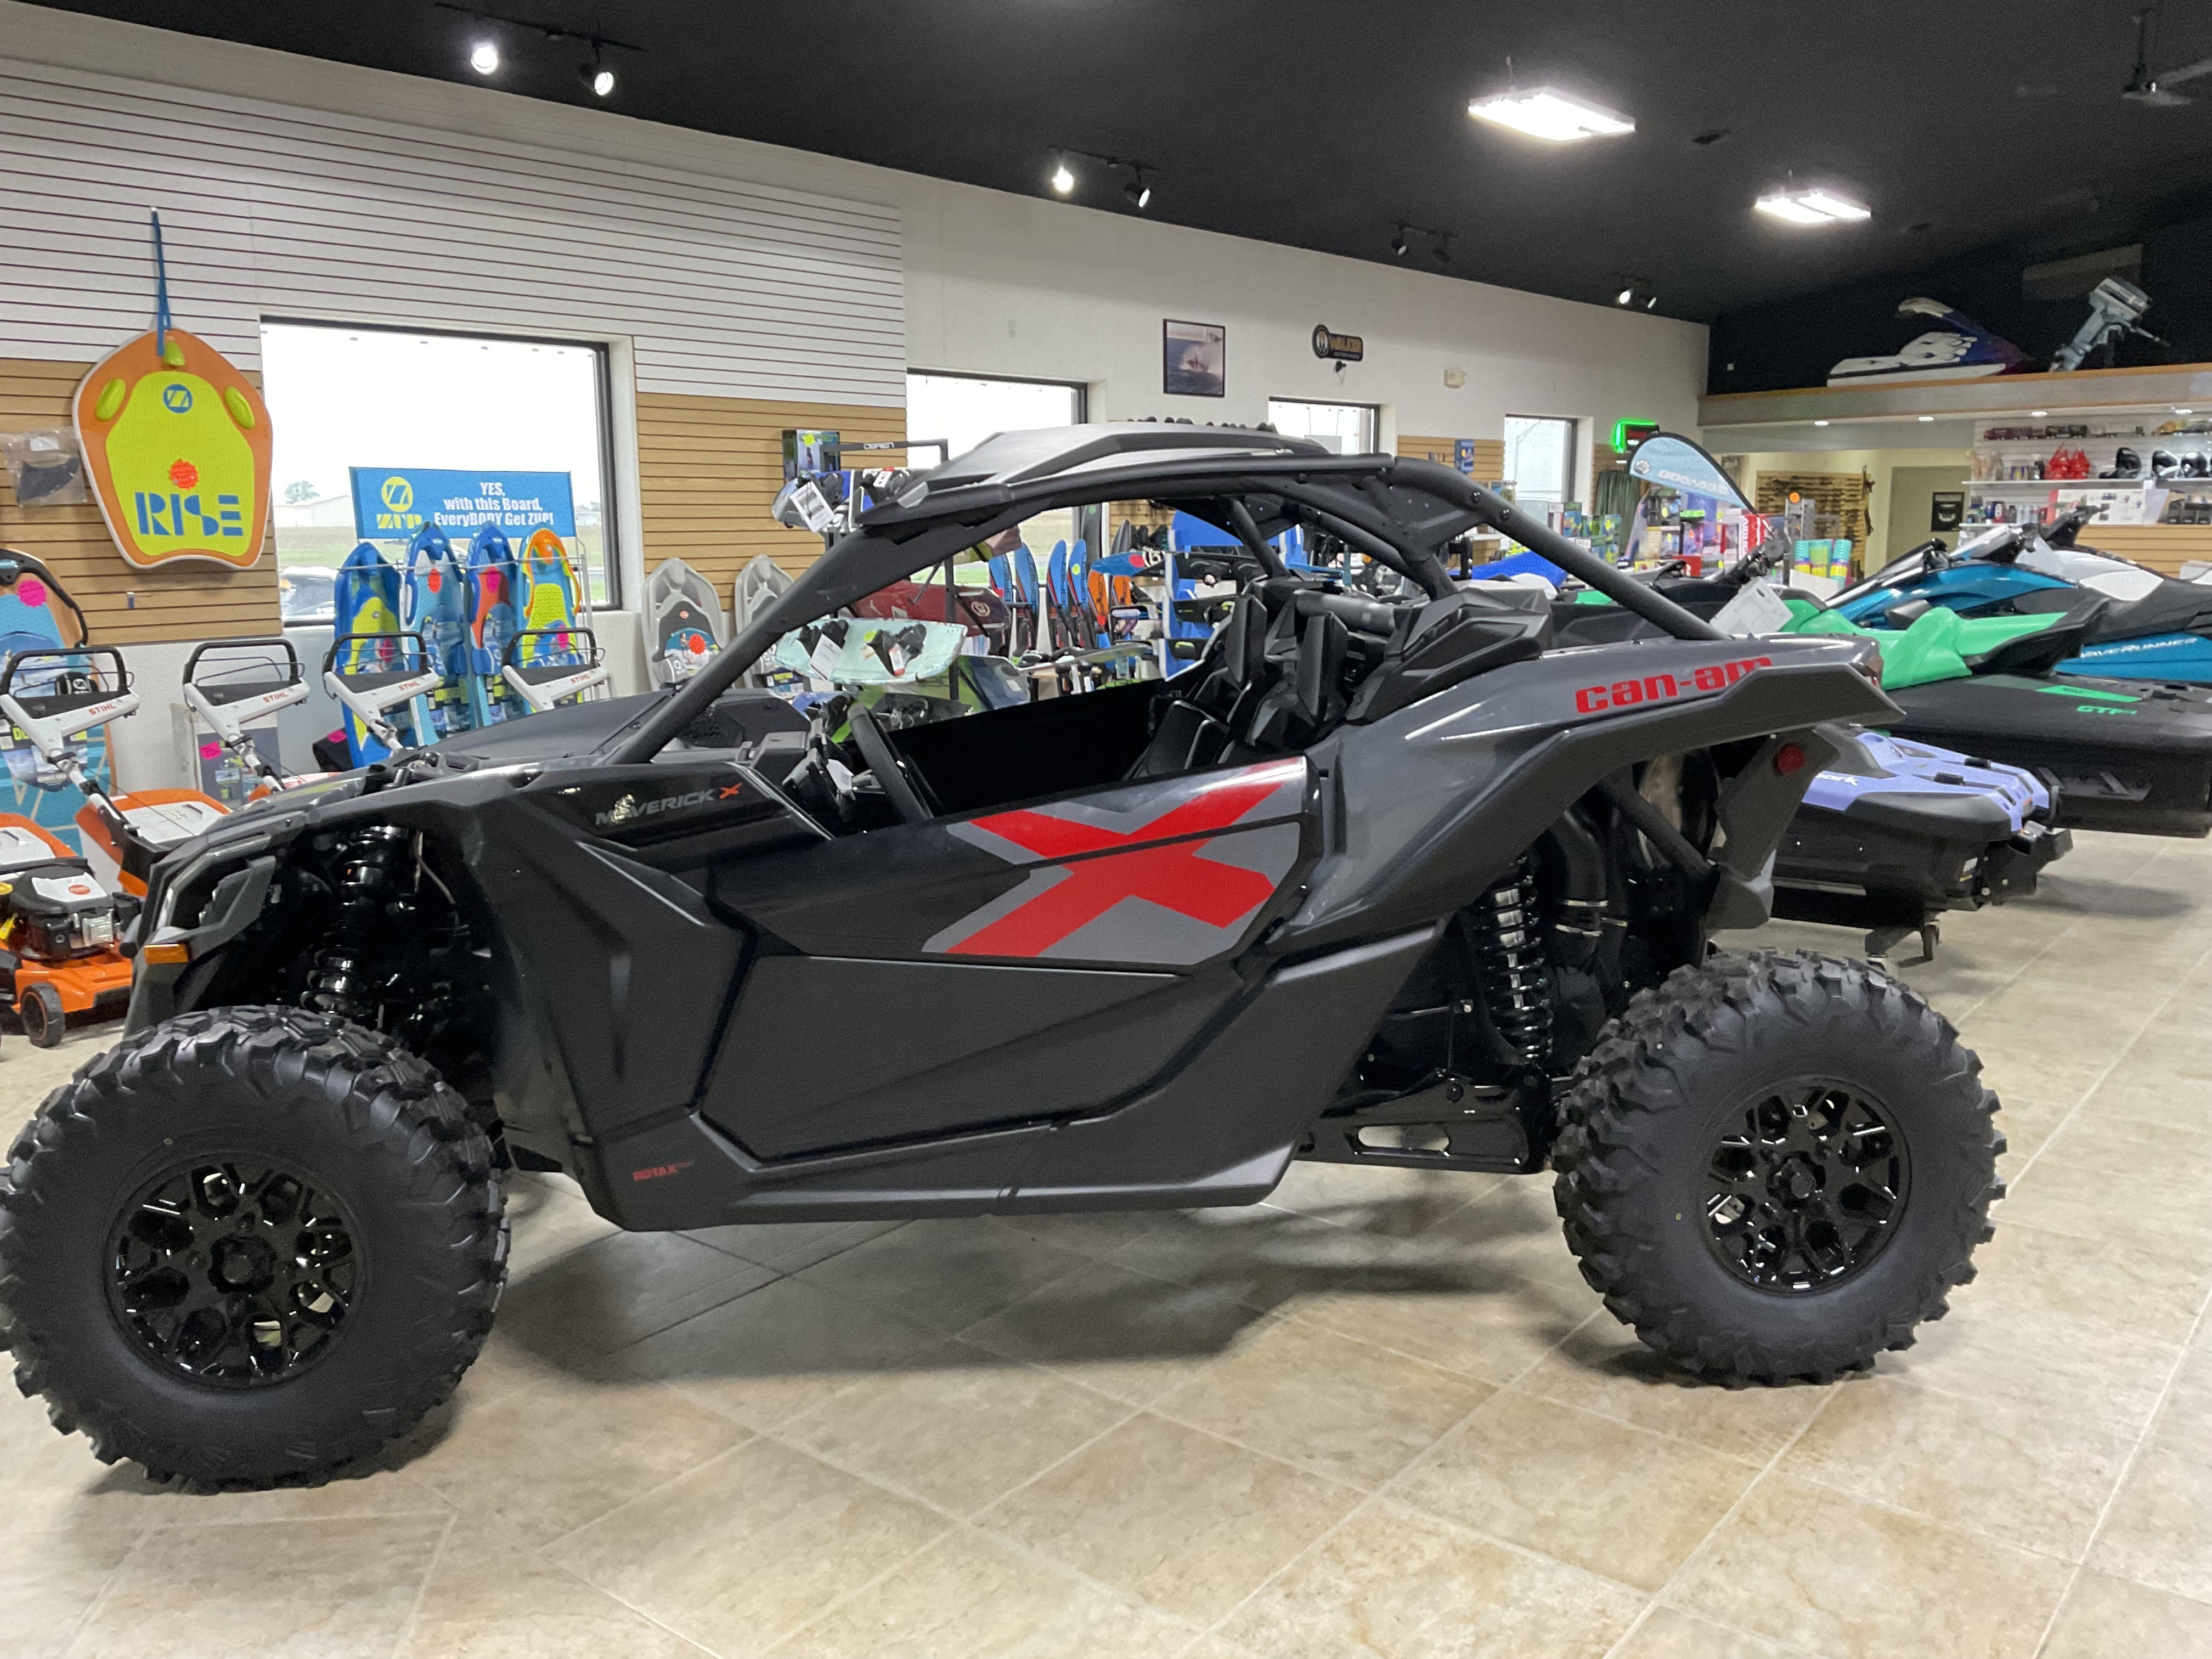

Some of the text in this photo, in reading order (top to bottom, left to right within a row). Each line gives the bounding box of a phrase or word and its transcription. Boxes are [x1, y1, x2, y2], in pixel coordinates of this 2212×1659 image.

[480, 482, 506, 496] YES,
[444, 497, 544, 511] with this Board,
[134, 492, 244, 536] RISE
[505, 512, 526, 526] Get
[376, 514, 422, 529] ZUP
[398, 681, 421, 691] STIHL
[570, 674, 591, 684] STIHL
[263, 691, 289, 703] STIHL
[89, 703, 117, 715] STIHL
[596, 789, 714, 825] MAVERICK
